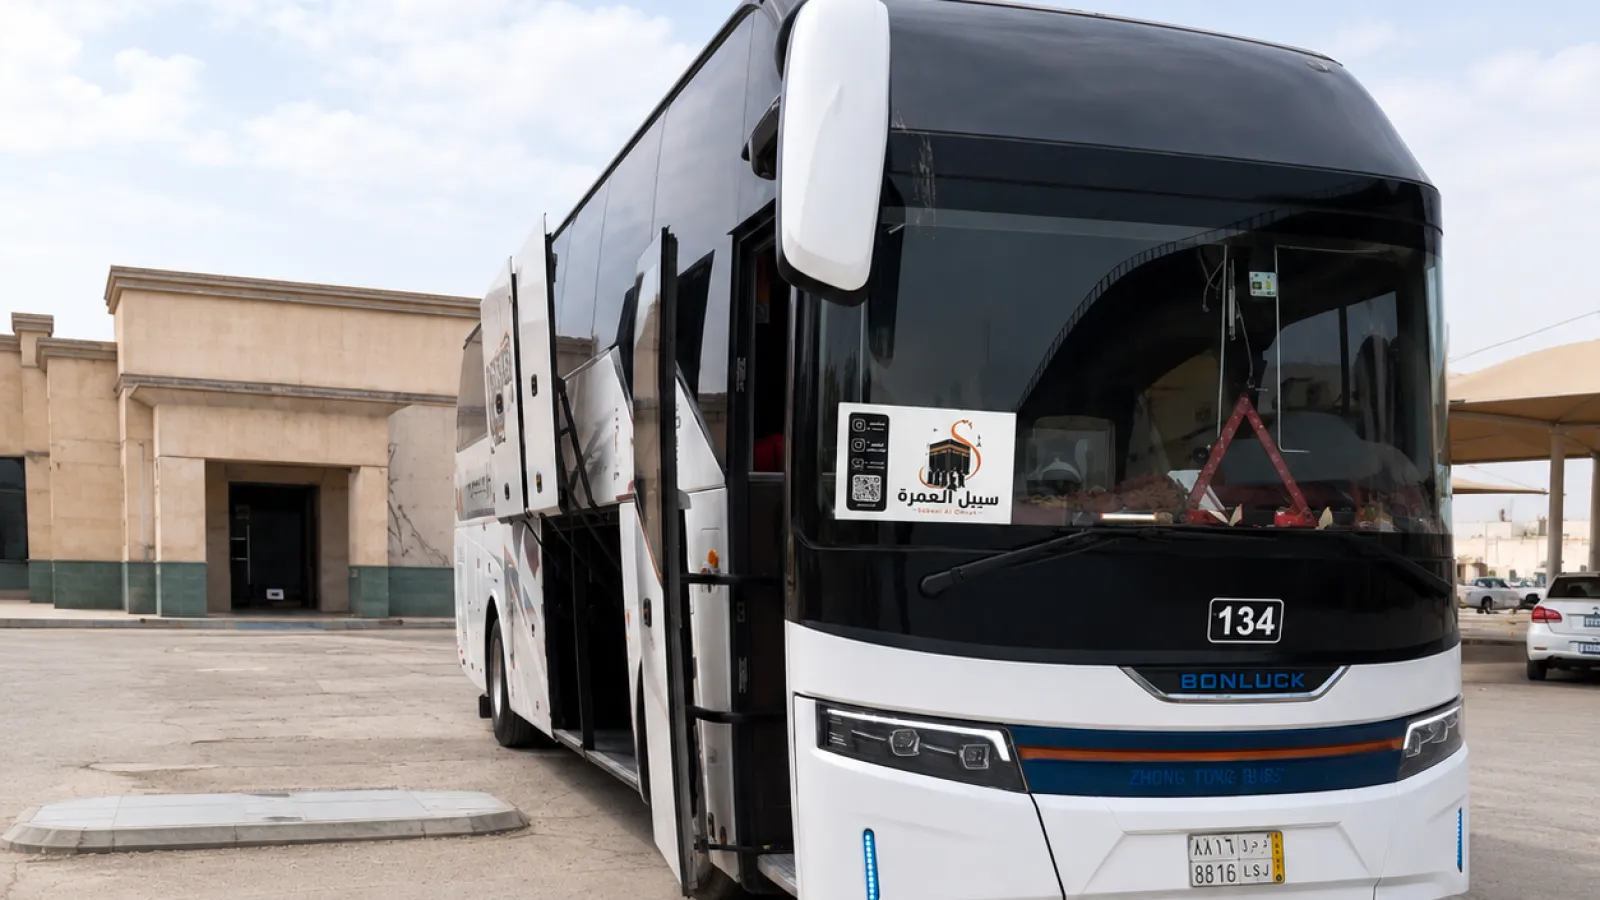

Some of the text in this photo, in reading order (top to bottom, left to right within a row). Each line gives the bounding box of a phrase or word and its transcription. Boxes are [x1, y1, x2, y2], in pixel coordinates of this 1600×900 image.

[897, 488, 999, 508] سبيل العمرة
[1218, 606, 1275, 636] 134
[1180, 673, 1305, 689] BONLUCK
[1129, 769, 1186, 786] ZHONG
[1195, 863, 1269, 884] 8816 LSJ
